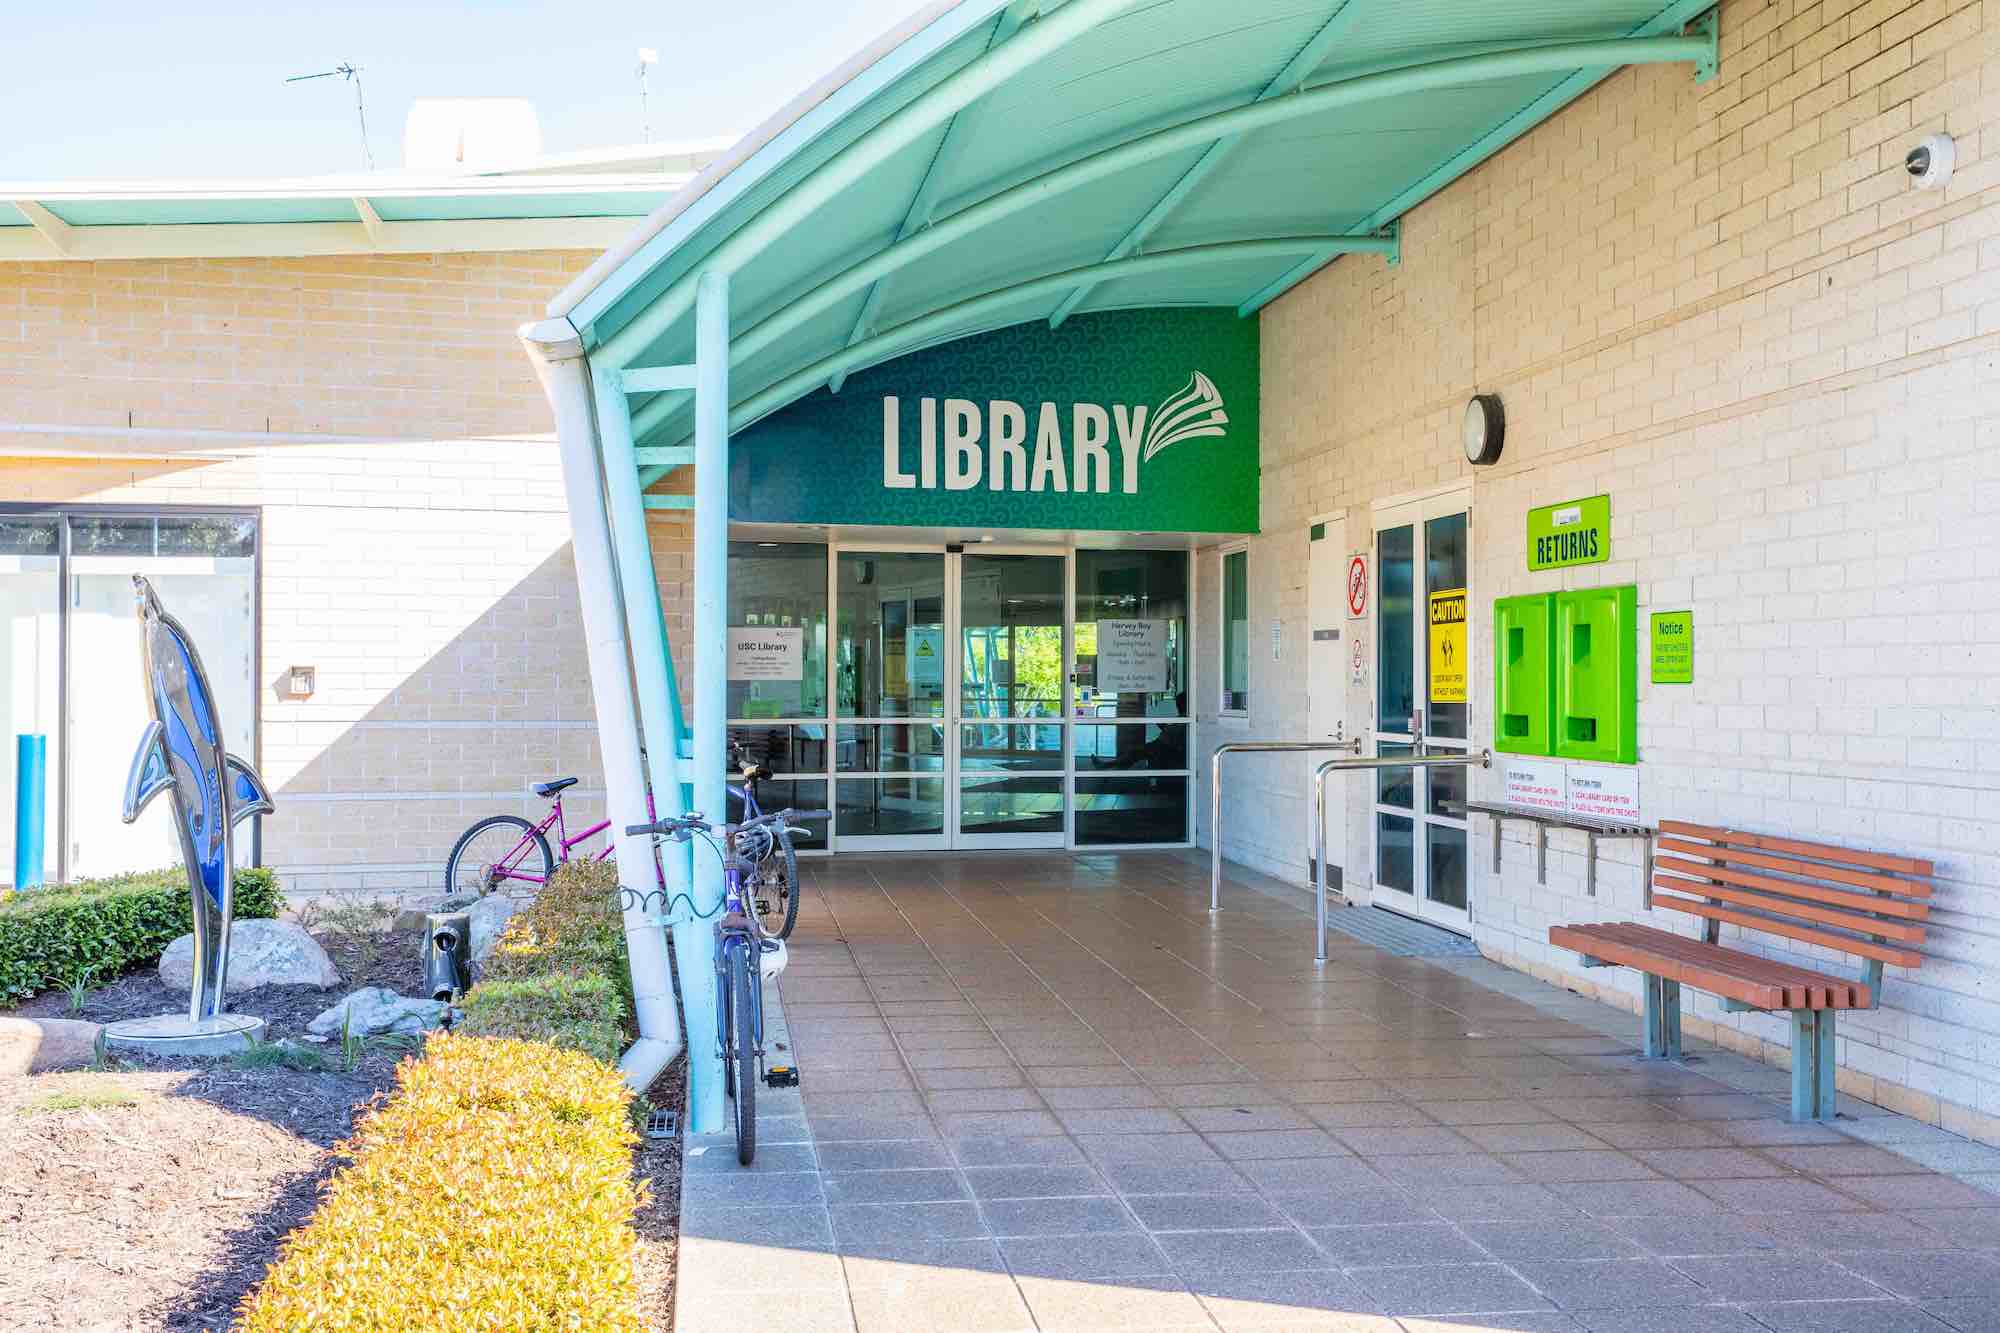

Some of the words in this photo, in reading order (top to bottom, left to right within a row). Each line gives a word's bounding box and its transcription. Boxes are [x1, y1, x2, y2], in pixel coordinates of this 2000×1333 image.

[884, 396, 1148, 494] LIBRARY
[1537, 527, 1598, 564] RETURNS
[1432, 598, 1465, 622] CAUTION
[1659, 622, 1683, 635] Notice
[738, 643, 757, 651] USC
[758, 642, 788, 652] Library
